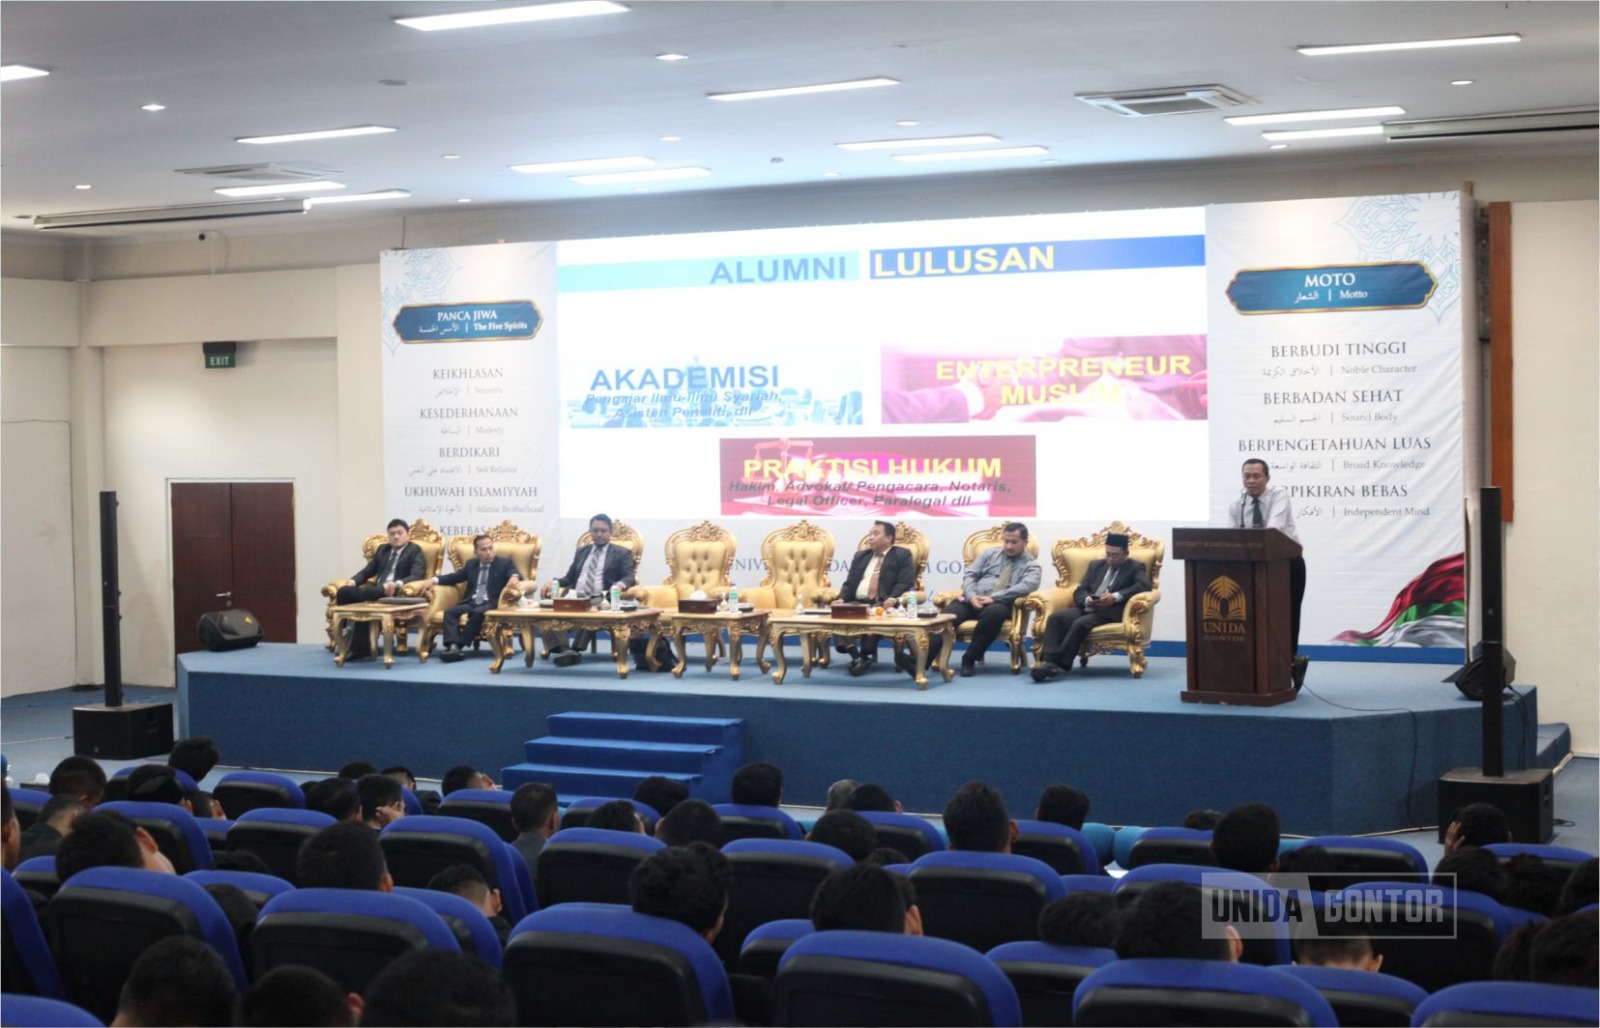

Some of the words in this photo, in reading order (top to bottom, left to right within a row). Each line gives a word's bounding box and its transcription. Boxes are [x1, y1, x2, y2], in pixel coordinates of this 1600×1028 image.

[709, 256, 847, 284] ALUMNI
[874, 245, 1055, 278] LULUSAN
[1304, 273, 1356, 287] MOTO
[1339, 289, 1368, 299] Motto
[437, 310, 471, 322] PANCA
[473, 309, 498, 321] JIWA
[473, 323, 487, 331] The
[488, 322, 503, 331] Five
[504, 321, 528, 332] Spirits
[1271, 343, 1340, 358] BERBUDI
[1345, 341, 1407, 355] TINGGI
[210, 356, 230, 366] EXIT
[936, 355, 1192, 380] ENTERPRENEUR
[432, 367, 504, 380] KEIKHLASAN
[1341, 364, 1369, 374] Noble
[1371, 363, 1417, 374] Character
[589, 364, 780, 391] AKADEMISI
[587, 393, 647, 406] Pengajar
[723, 391, 782, 404] Syariah,
[1000, 383, 1123, 406] MUSLIM
[1263, 391, 1347, 405] BERBADAN
[1352, 389, 1404, 402] SEHAT
[419, 407, 519, 419] KESEDERHANAAN
[735, 406, 752, 416] dll
[1341, 412, 1371, 422] Sound
[1374, 412, 1398, 423] Body
[1238, 437, 1387, 452] BERPENGETAHUAN
[1393, 437, 1432, 449] LUAS
[439, 447, 500, 458] BERDIKARI
[743, 458, 880, 479] PRAKTISI
[888, 457, 1002, 478] HUKUM
[1342, 459, 1370, 469] Broad
[1373, 458, 1427, 471] Knowledge
[404, 486, 465, 497] UKHUWAH
[469, 486, 538, 497] ISLAMIYYAH
[728, 480, 780, 492] Hakim,
[856, 480, 943, 494] Pengacara,
[948, 480, 1012, 493] Notaris,
[1281, 485, 1356, 497] PIKIRAN
[1361, 485, 1408, 497] BEBAS
[767, 495, 807, 508] Legal
[812, 495, 867, 508] Officer,
[872, 495, 948, 508] Paralegal
[951, 495, 972, 507] dll
[1343, 506, 1403, 519] Independent
[1404, 506, 1430, 516] Mind
[439, 525, 490, 537] KEBEBAS
[1203, 621, 1246, 634] UNIDA
